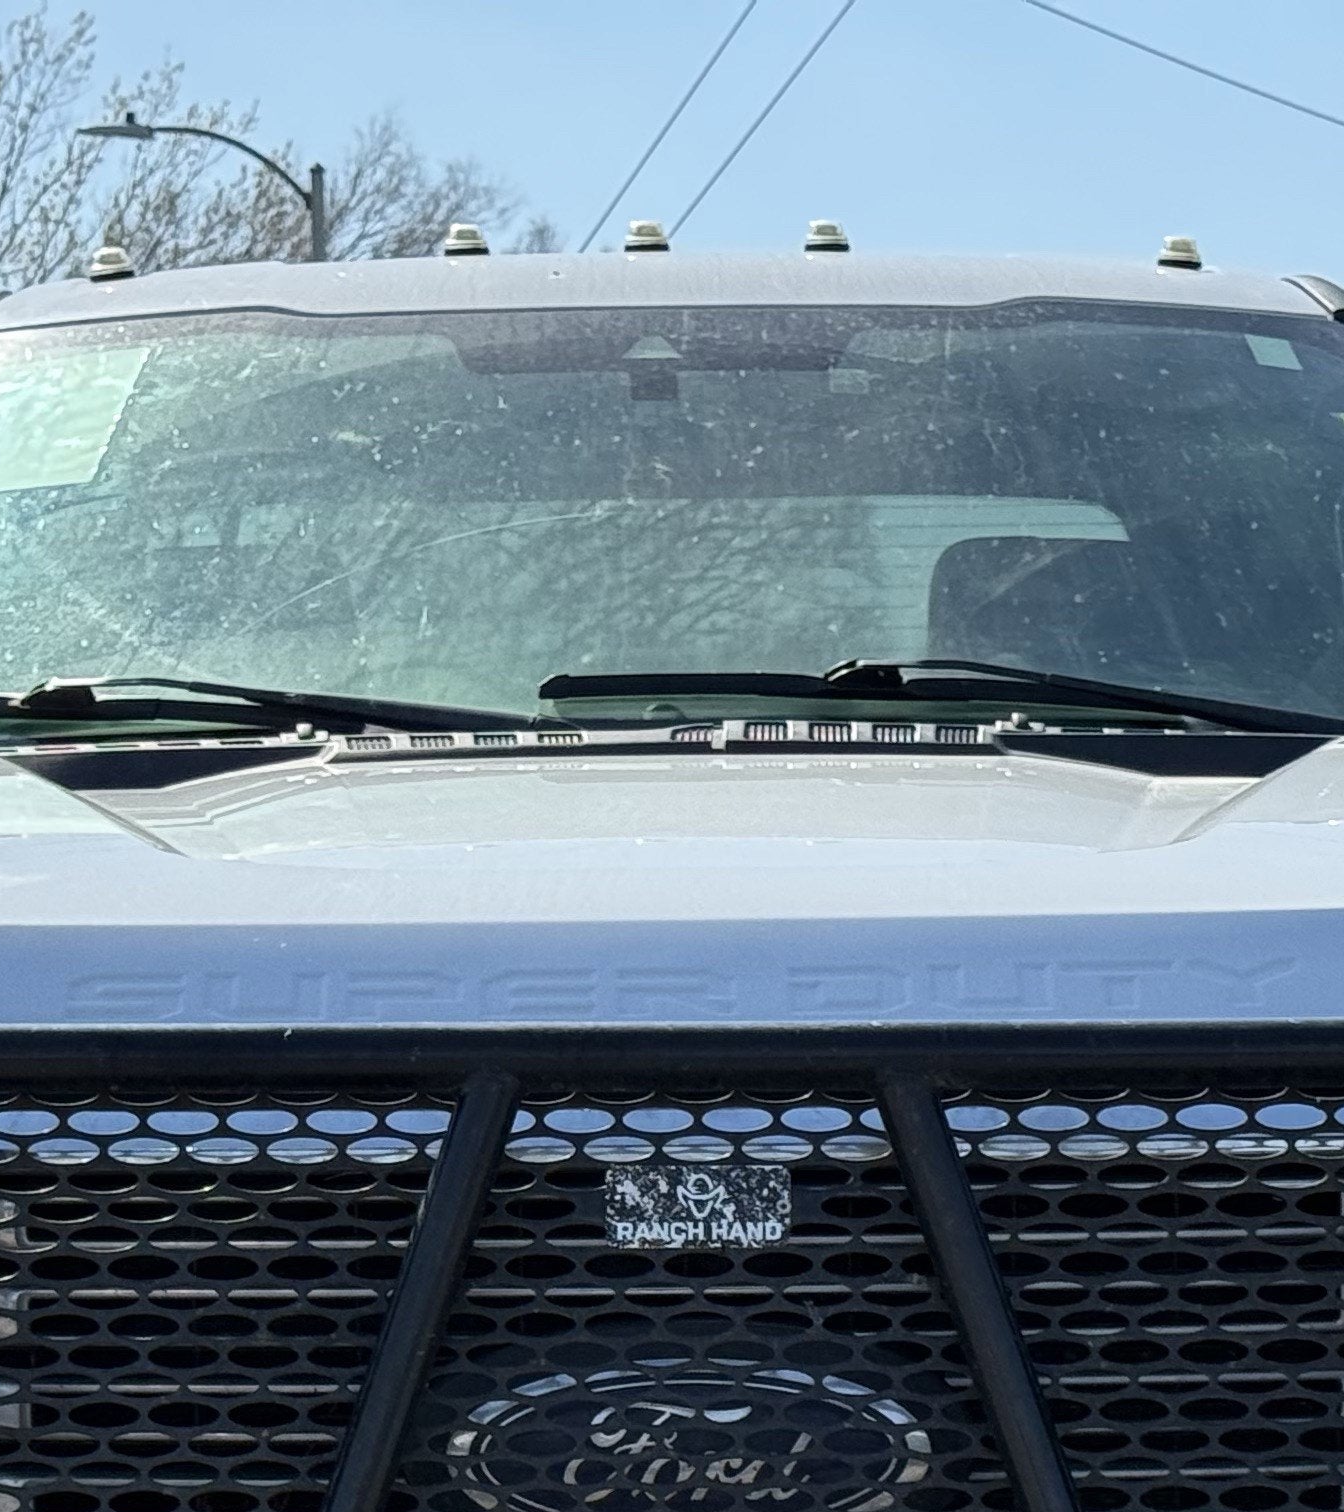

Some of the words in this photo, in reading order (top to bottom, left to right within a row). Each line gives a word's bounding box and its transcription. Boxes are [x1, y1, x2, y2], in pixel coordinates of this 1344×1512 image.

[63, 970, 738, 1021] SUPER
[785, 956, 1300, 1018] DUTY
[615, 1220, 705, 1242] RANCH
[711, 1220, 783, 1242] HAND
